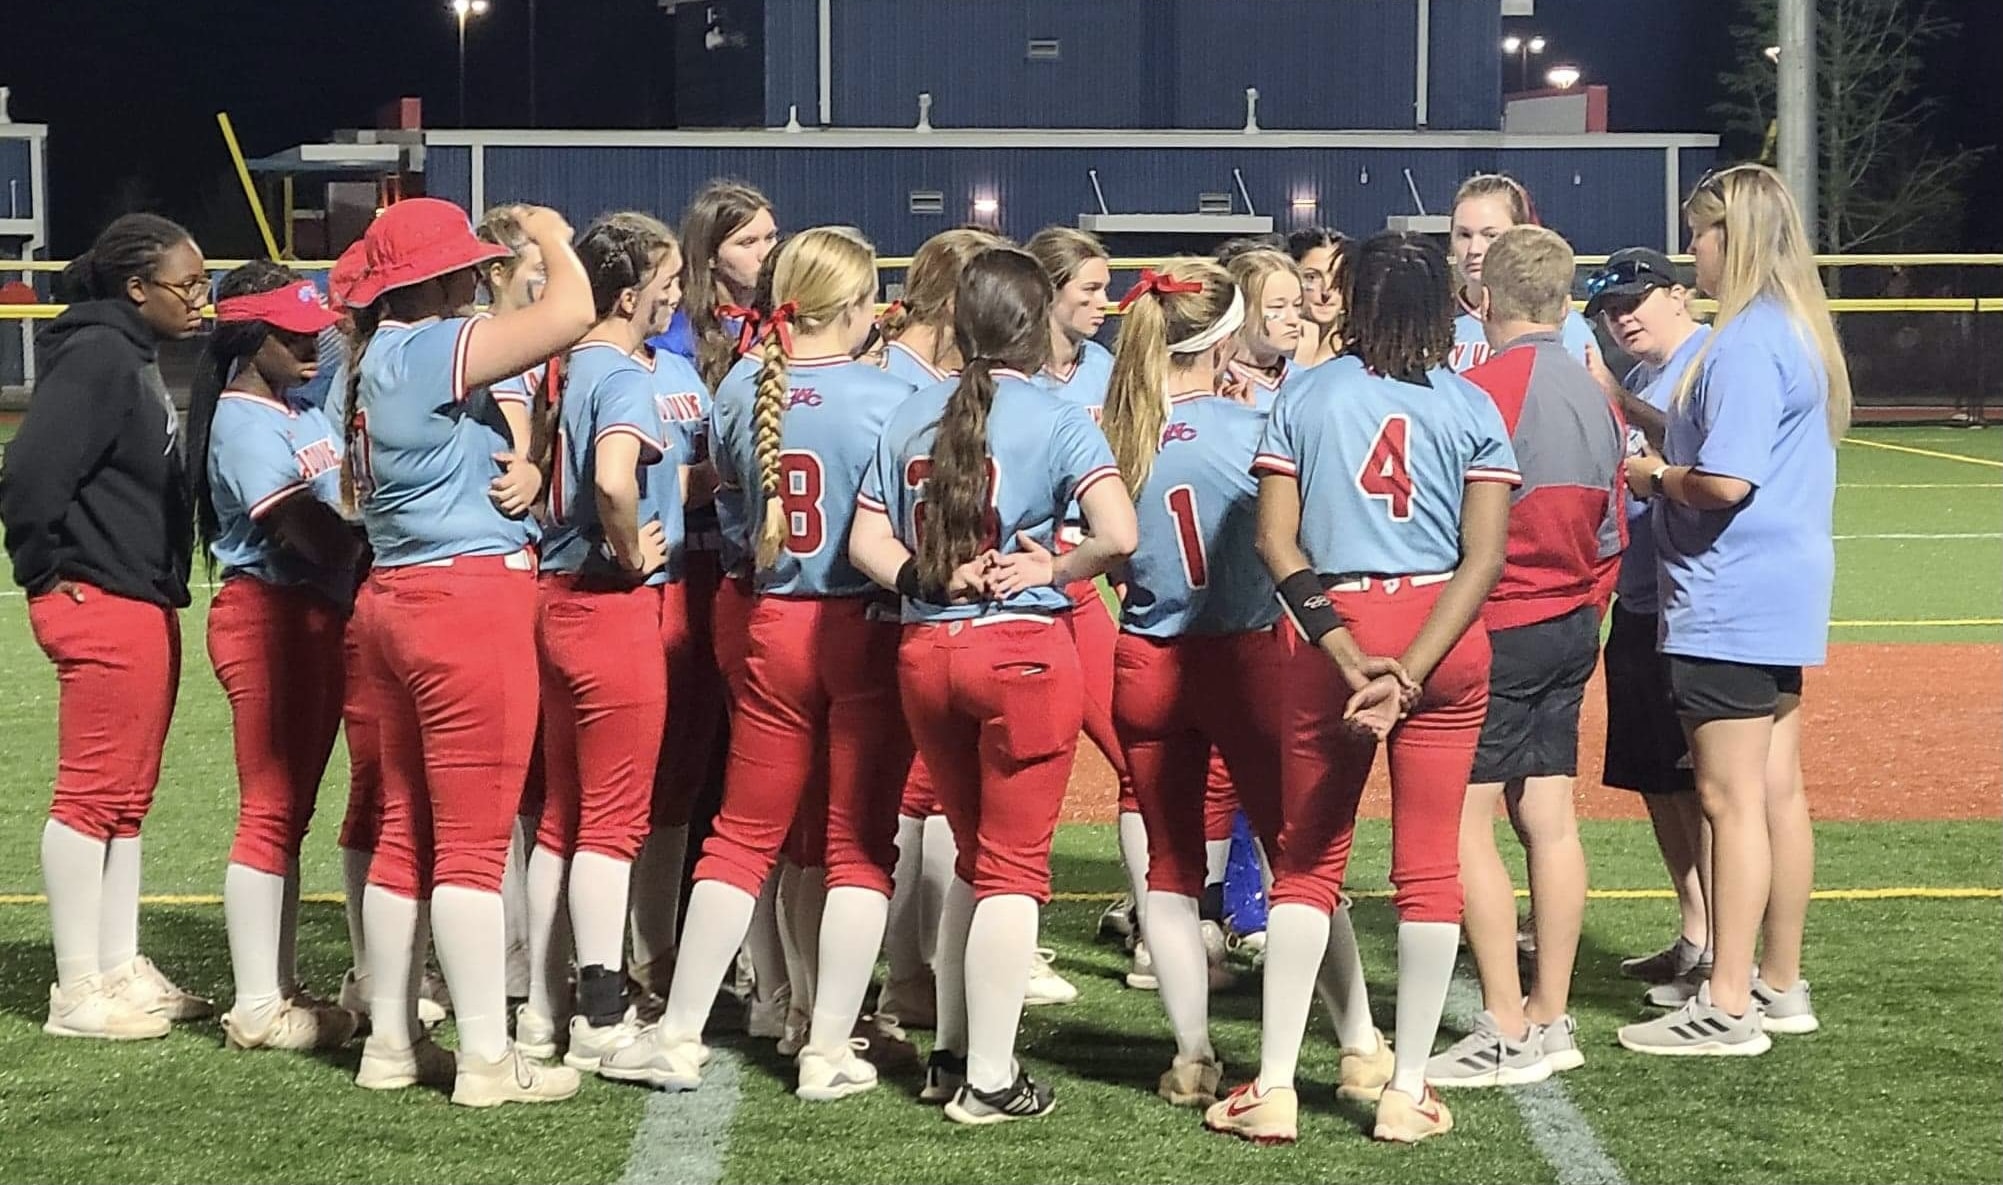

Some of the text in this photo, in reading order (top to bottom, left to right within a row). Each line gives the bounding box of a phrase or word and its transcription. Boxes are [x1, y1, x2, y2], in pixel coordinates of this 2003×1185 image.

[776, 449, 826, 558] 8
[1355, 413, 1416, 521] 4
[1164, 484, 1208, 590] 1
